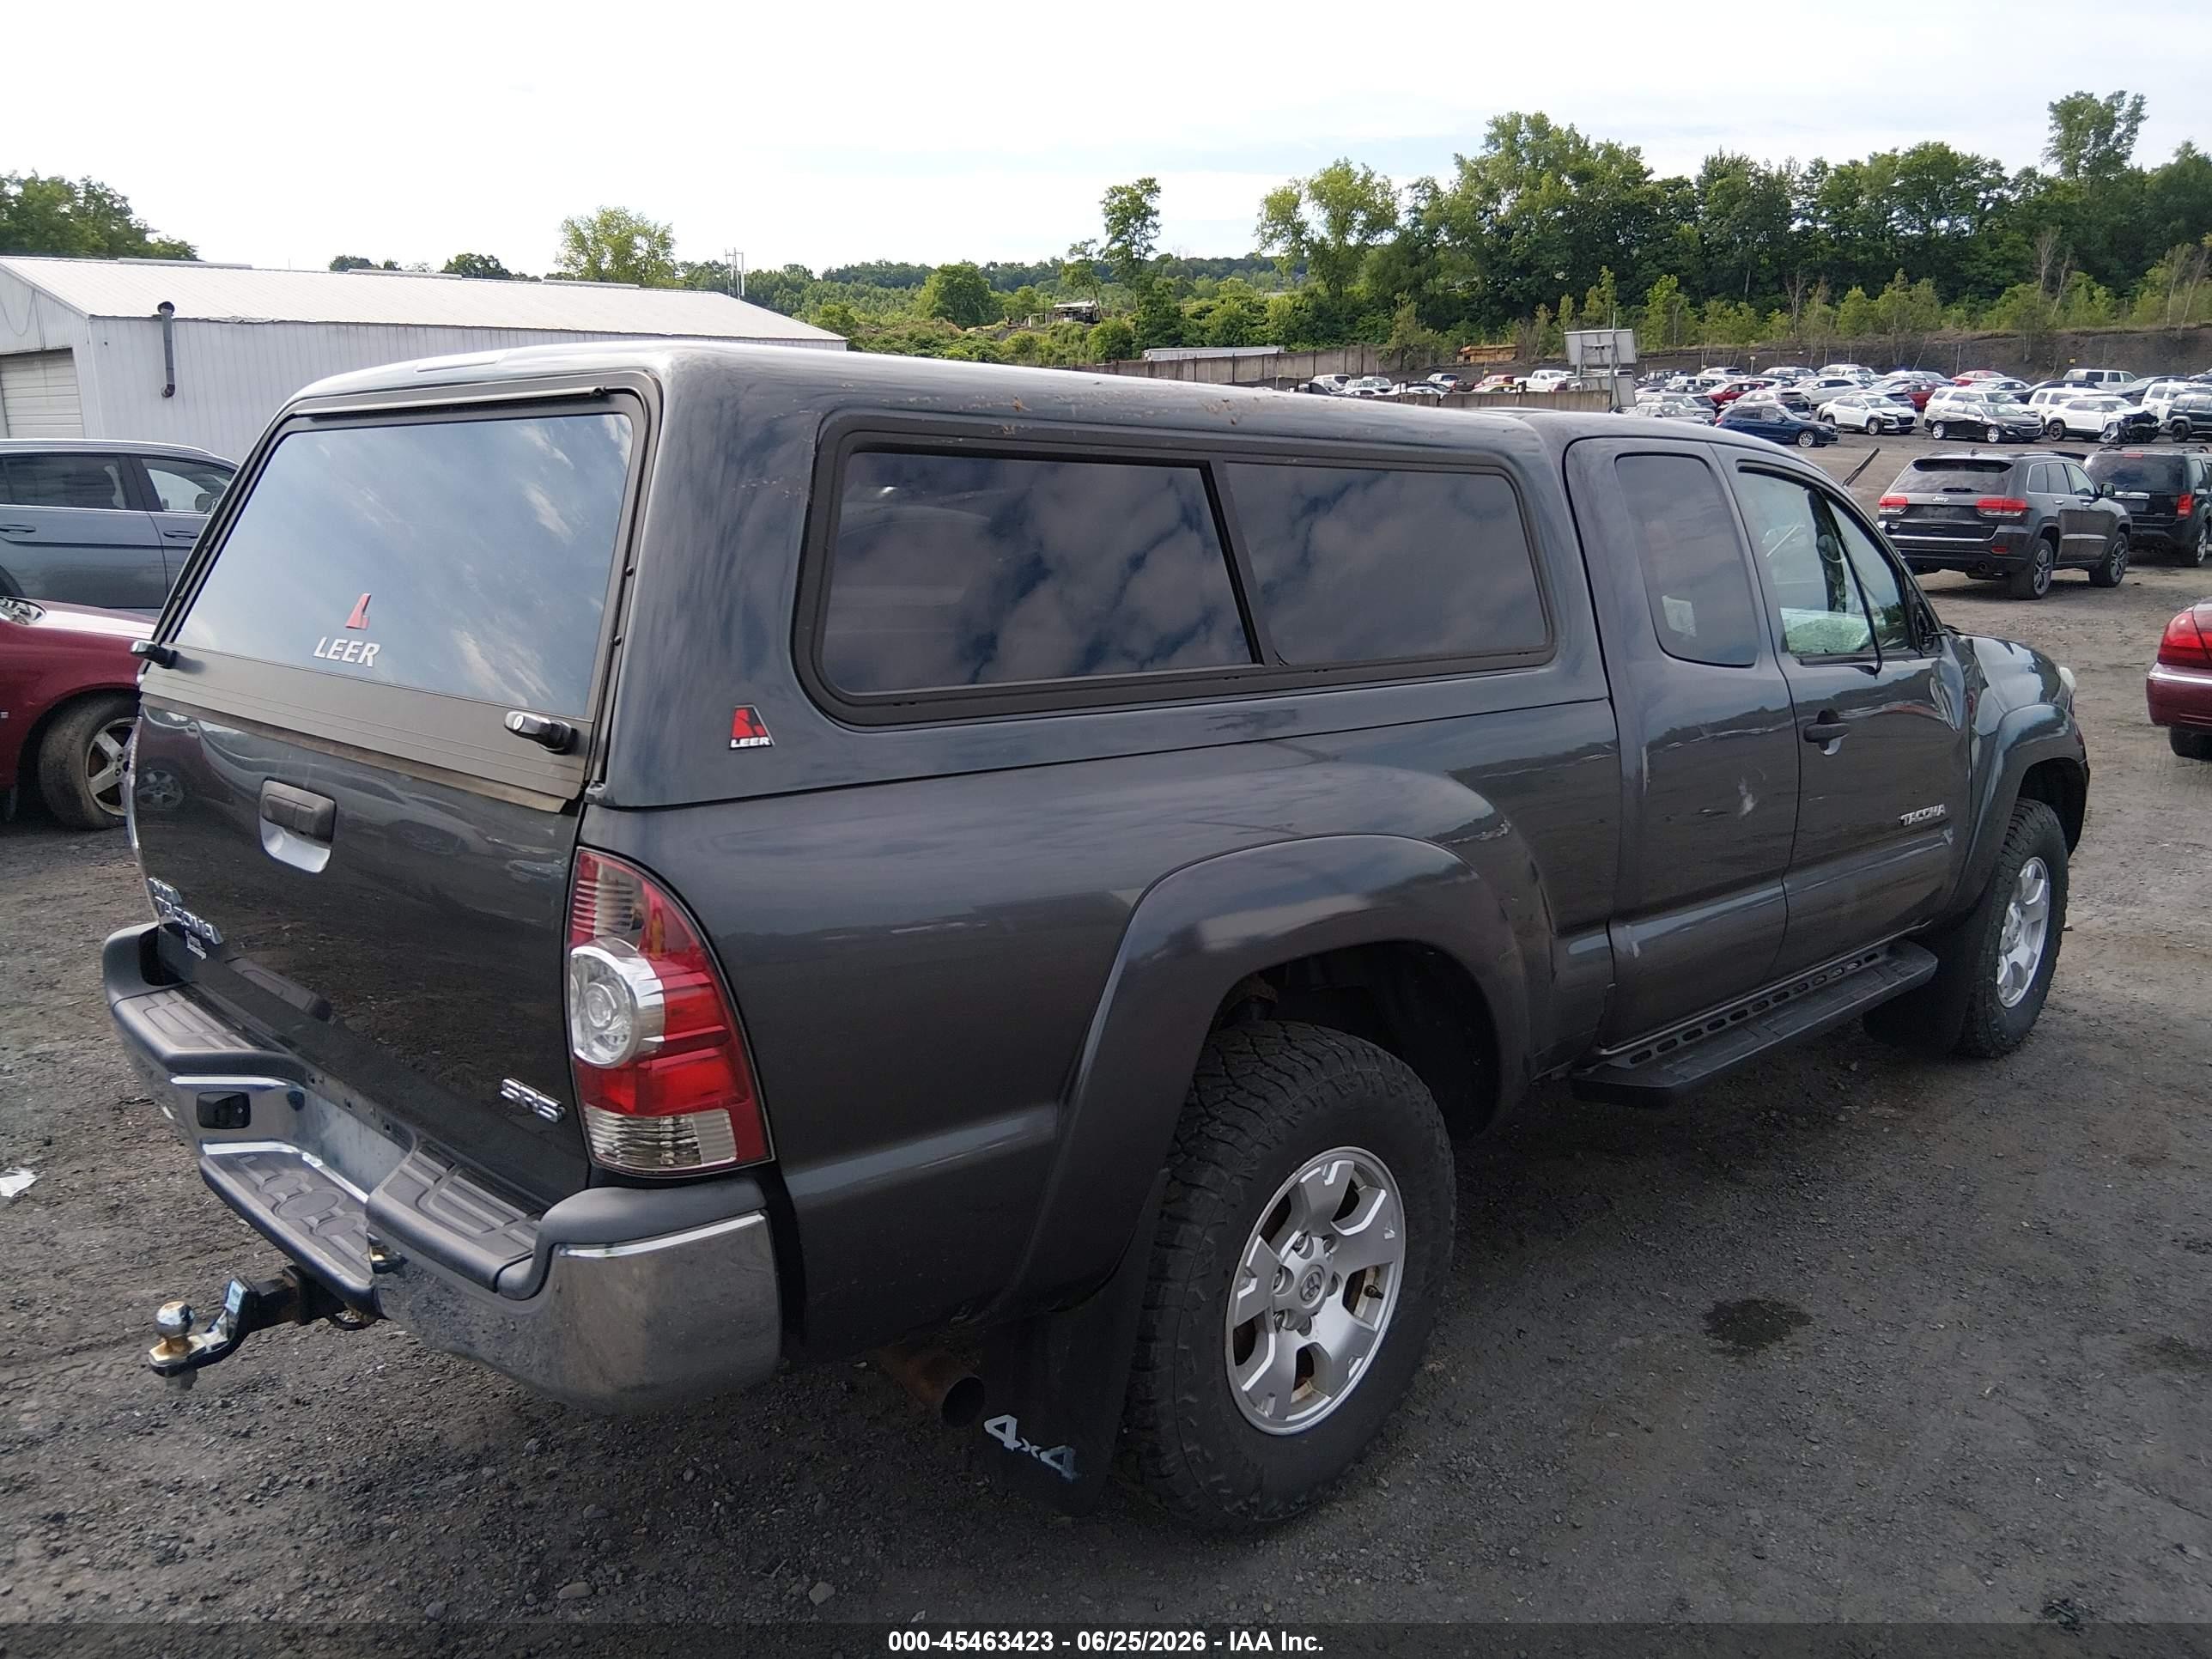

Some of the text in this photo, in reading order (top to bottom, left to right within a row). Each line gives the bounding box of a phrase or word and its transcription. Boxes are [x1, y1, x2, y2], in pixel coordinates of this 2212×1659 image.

[313, 636, 381, 667] LEER
[730, 736, 771, 748] LEER
[1899, 804, 1947, 826] TACOMA
[501, 1079, 563, 1122] SR5
[984, 1414, 1079, 1484] 4x4
